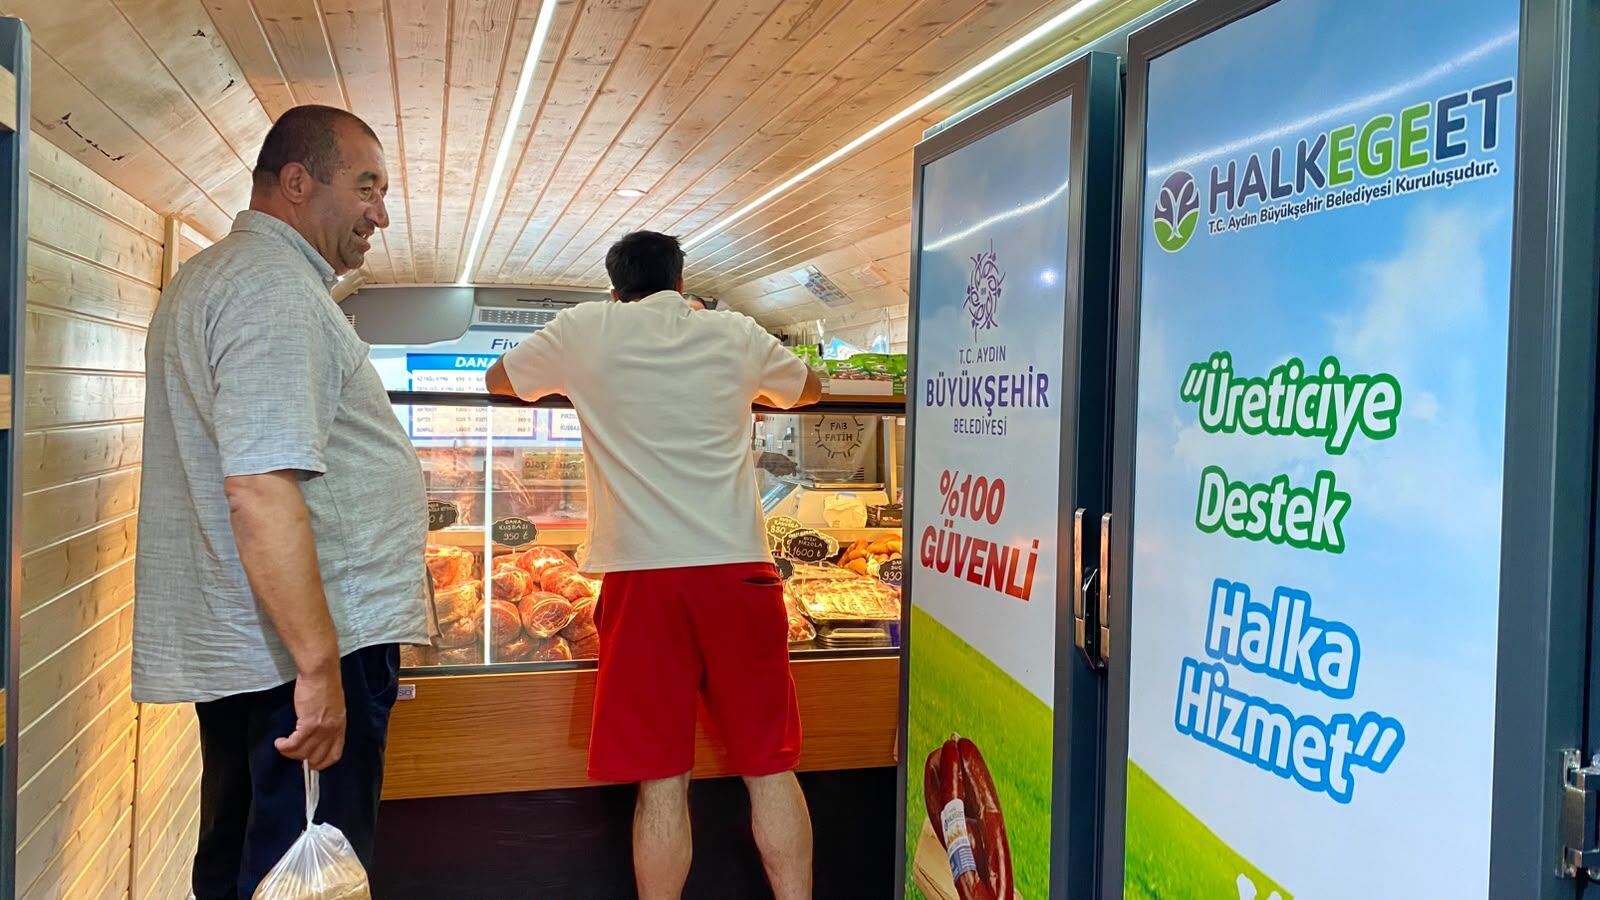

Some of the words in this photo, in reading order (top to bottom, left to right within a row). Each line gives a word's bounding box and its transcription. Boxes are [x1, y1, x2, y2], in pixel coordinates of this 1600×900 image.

[1207, 79, 1514, 216] HALKEGEET
[1208, 219, 1226, 234] T.C.
[1228, 212, 1257, 231] Aydın
[1260, 199, 1323, 222] Büyükşehir
[1326, 180, 1391, 208] Belediyesi
[1395, 161, 1498, 192] Kuruluşudur.
[959, 348, 974, 365] T.C.
[977, 345, 1007, 362] AYDIN
[926, 365, 1050, 416] BÜYÜKŞEHİR
[825, 431, 853, 441] FATİH
[830, 422, 848, 430] FAB
[953, 416, 1008, 436] BELEDİYESİ
[940, 469, 1006, 525] %100
[1198, 470, 1348, 549] Destek
[793, 546, 814, 558] 1600
[882, 570, 903, 581] 930
[920, 518, 1040, 602] GÜVENLİ
[1208, 583, 1356, 693] Halka
